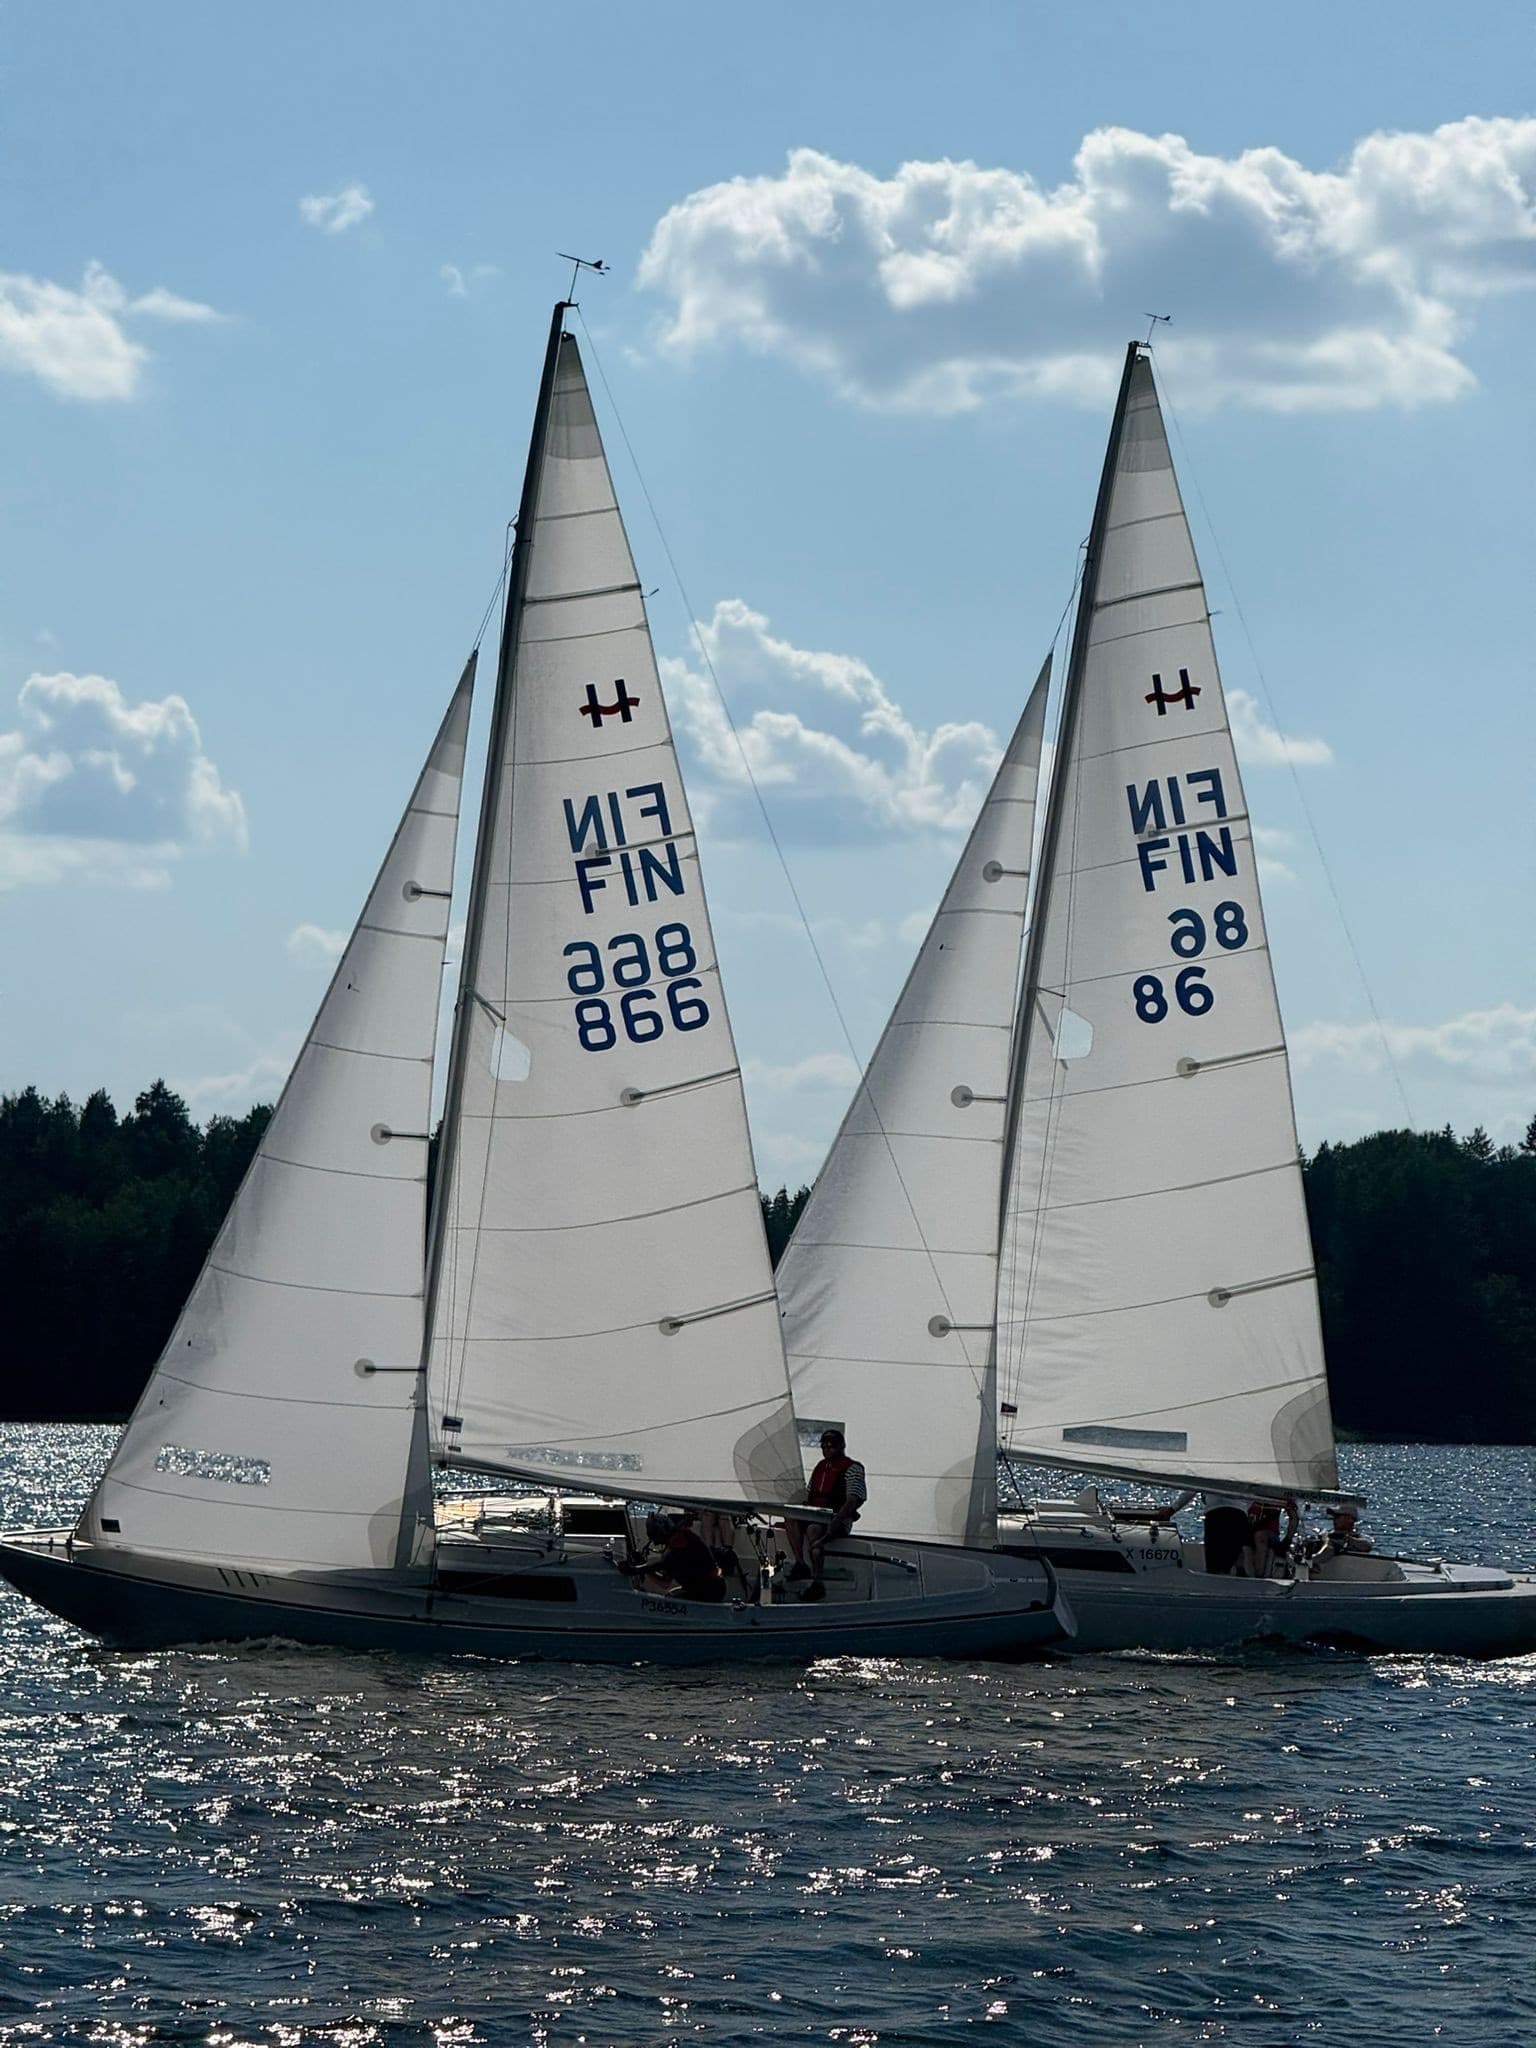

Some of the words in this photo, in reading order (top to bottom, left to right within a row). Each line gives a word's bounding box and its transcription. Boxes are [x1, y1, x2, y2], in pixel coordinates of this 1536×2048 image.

[575, 842, 685, 914] FIN
[1137, 826, 1238, 892] FIN
[575, 977, 710, 1052] 866
[1133, 966, 1214, 1024] 86
[1126, 1548, 1134, 1560] X
[1140, 1549, 1179, 1560] 16670
